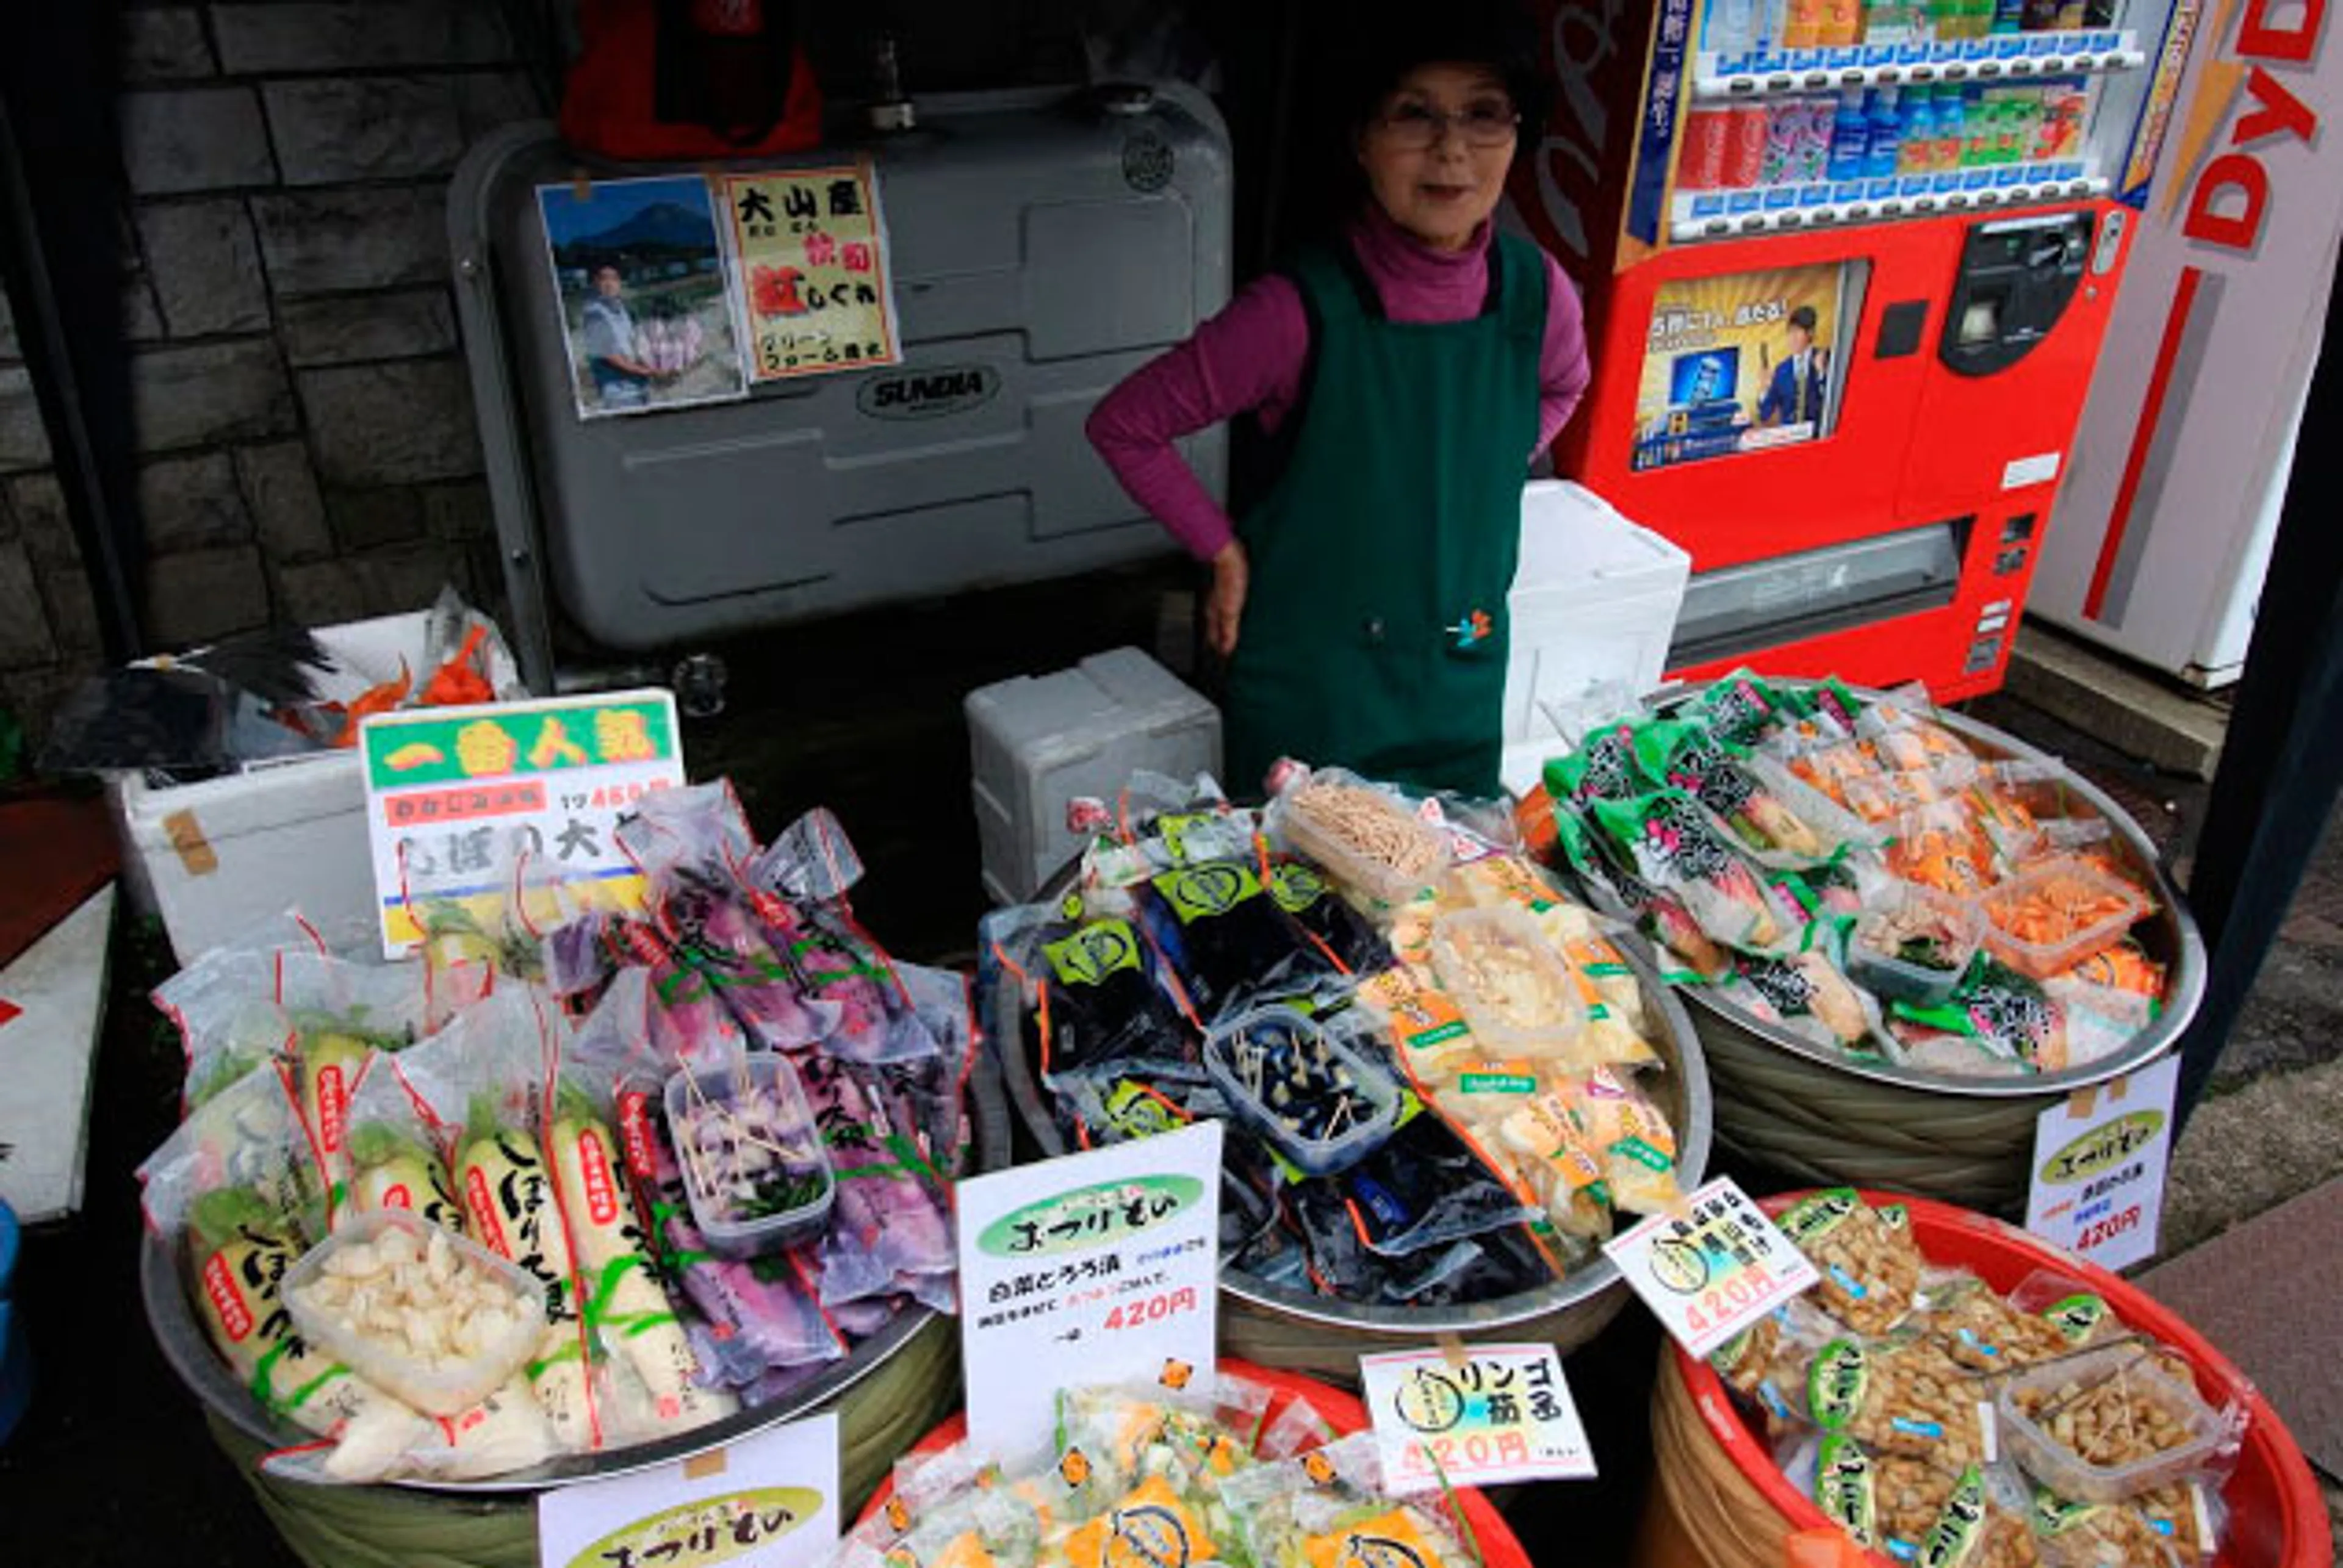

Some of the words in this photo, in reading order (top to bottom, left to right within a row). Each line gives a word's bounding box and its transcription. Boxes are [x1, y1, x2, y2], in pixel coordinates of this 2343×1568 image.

[1103, 1287, 1197, 1330] 420円
[1683, 1267, 1777, 1334] 420円
[1459, 1358, 1555, 1392] リンゴ
[1401, 1431, 1528, 1472] 420円
